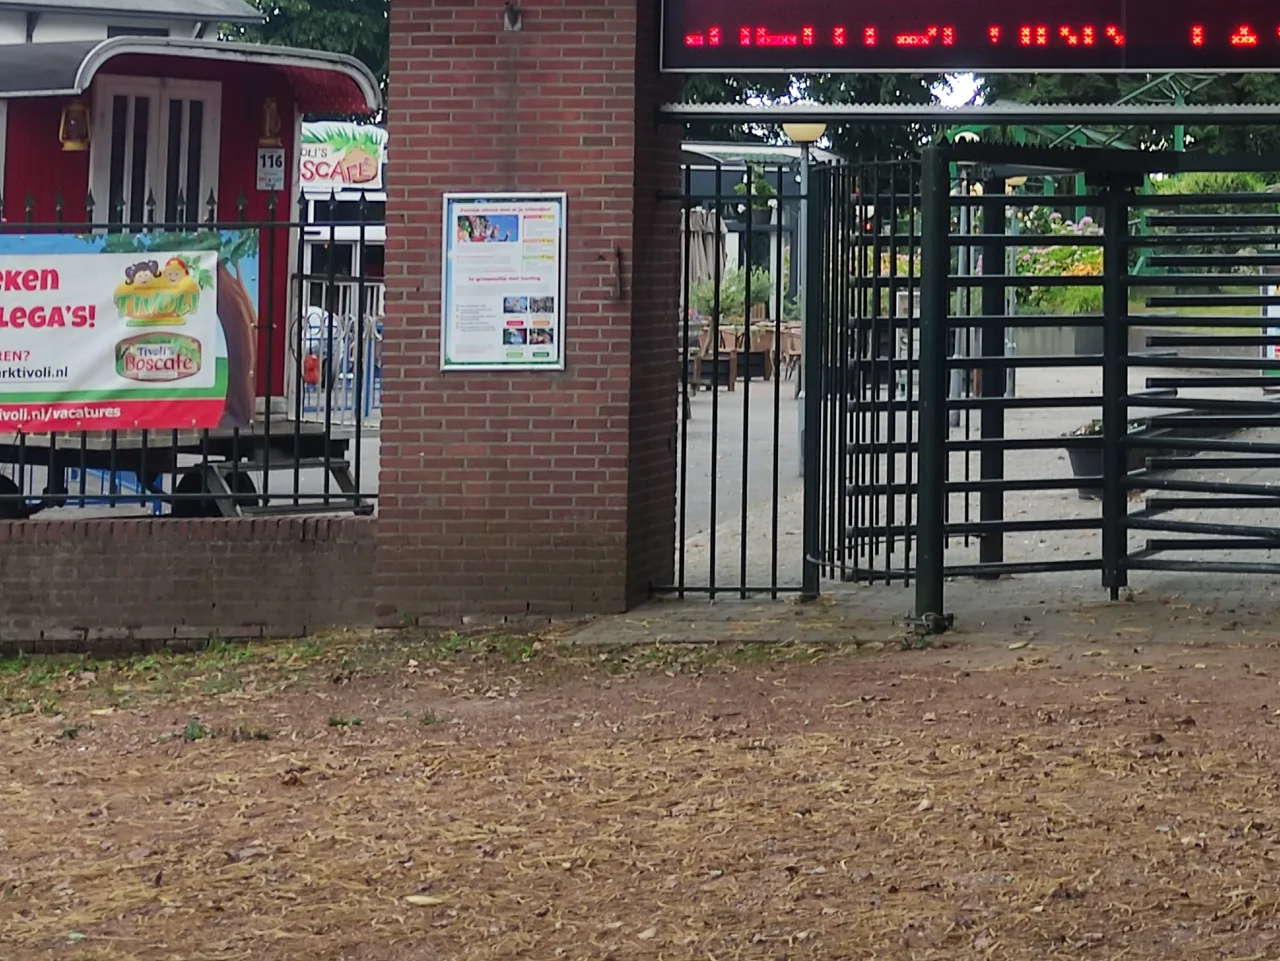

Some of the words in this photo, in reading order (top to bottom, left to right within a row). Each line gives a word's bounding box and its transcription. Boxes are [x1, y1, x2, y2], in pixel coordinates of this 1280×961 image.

[260, 153, 283, 169] 116
[0, 268, 60, 292] ken
[116, 289, 199, 317] TIVOLI
[0, 365, 68, 379] rktivoli.nl
